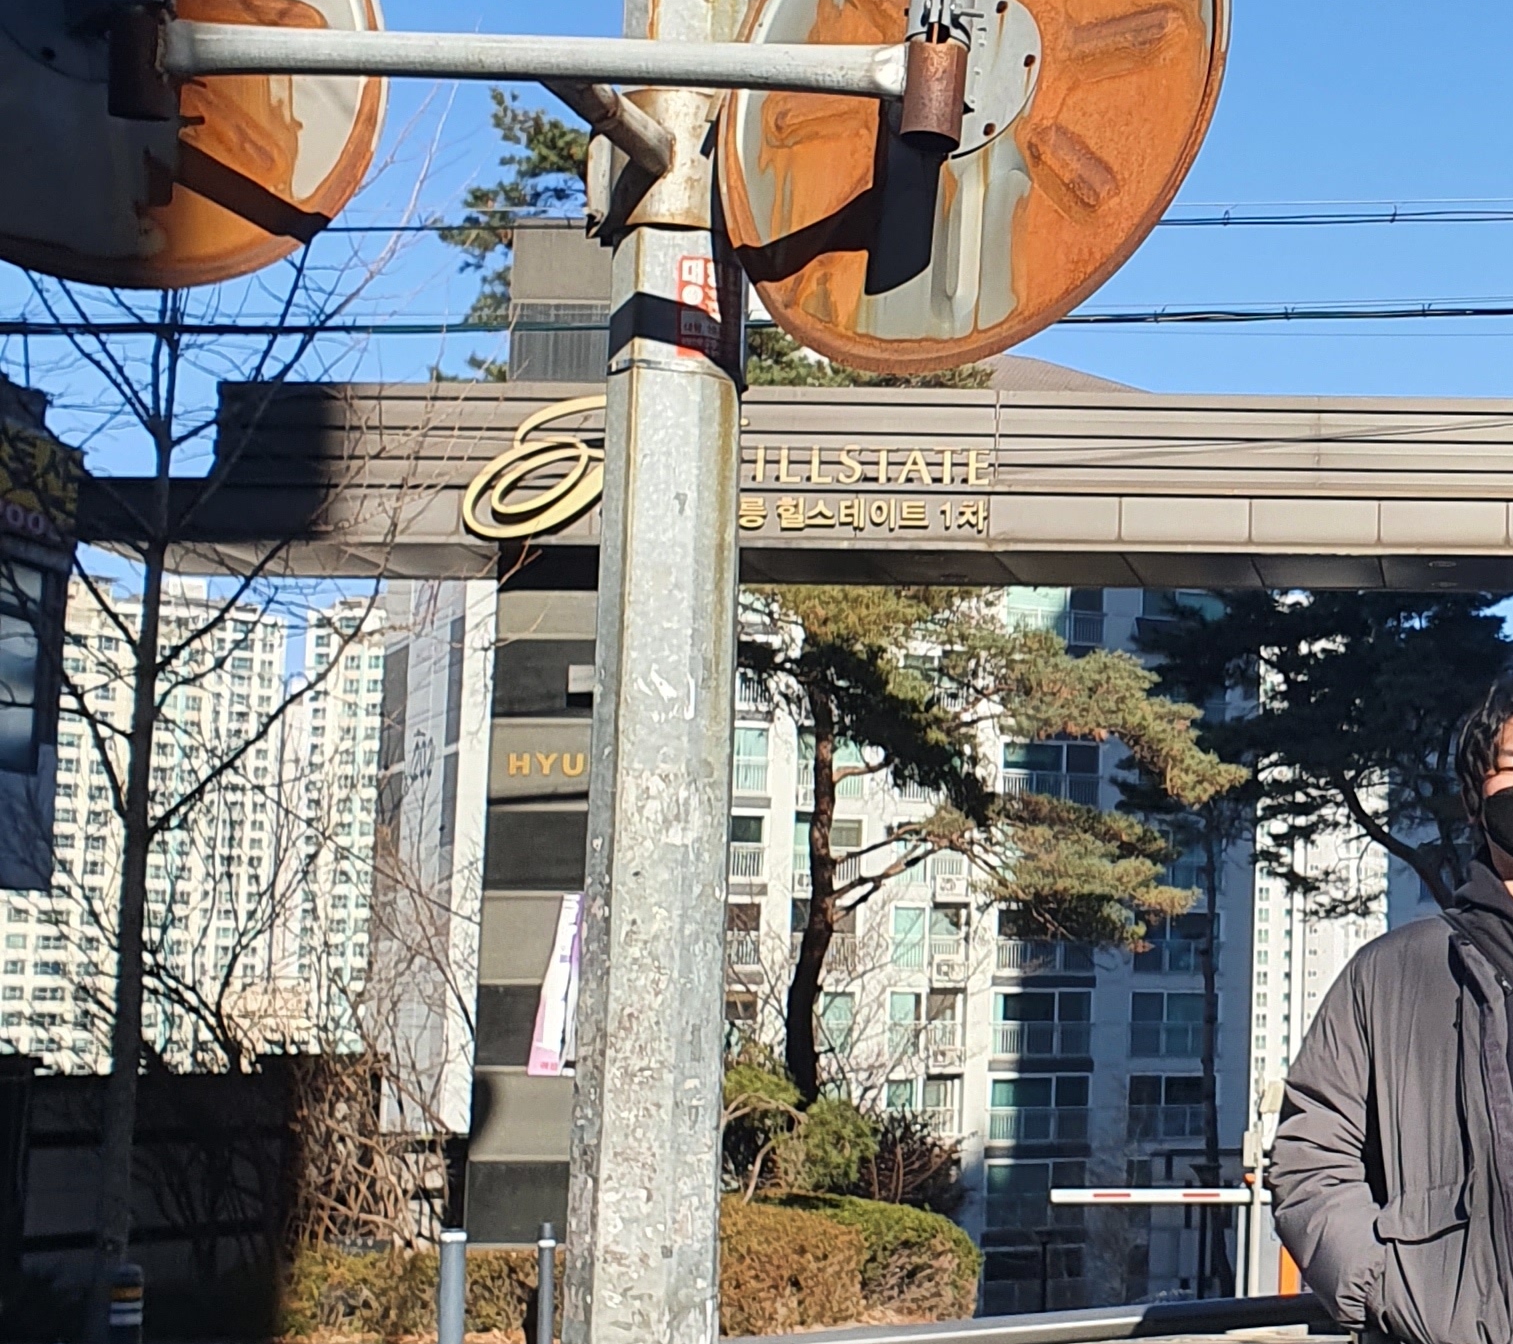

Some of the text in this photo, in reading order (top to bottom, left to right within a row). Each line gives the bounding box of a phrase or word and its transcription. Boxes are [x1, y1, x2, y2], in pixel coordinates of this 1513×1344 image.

[754, 444, 990, 486] ILLSTATE
[738, 496, 987, 531] 릉 힐스테이트 1차
[508, 752, 584, 777] HYU
